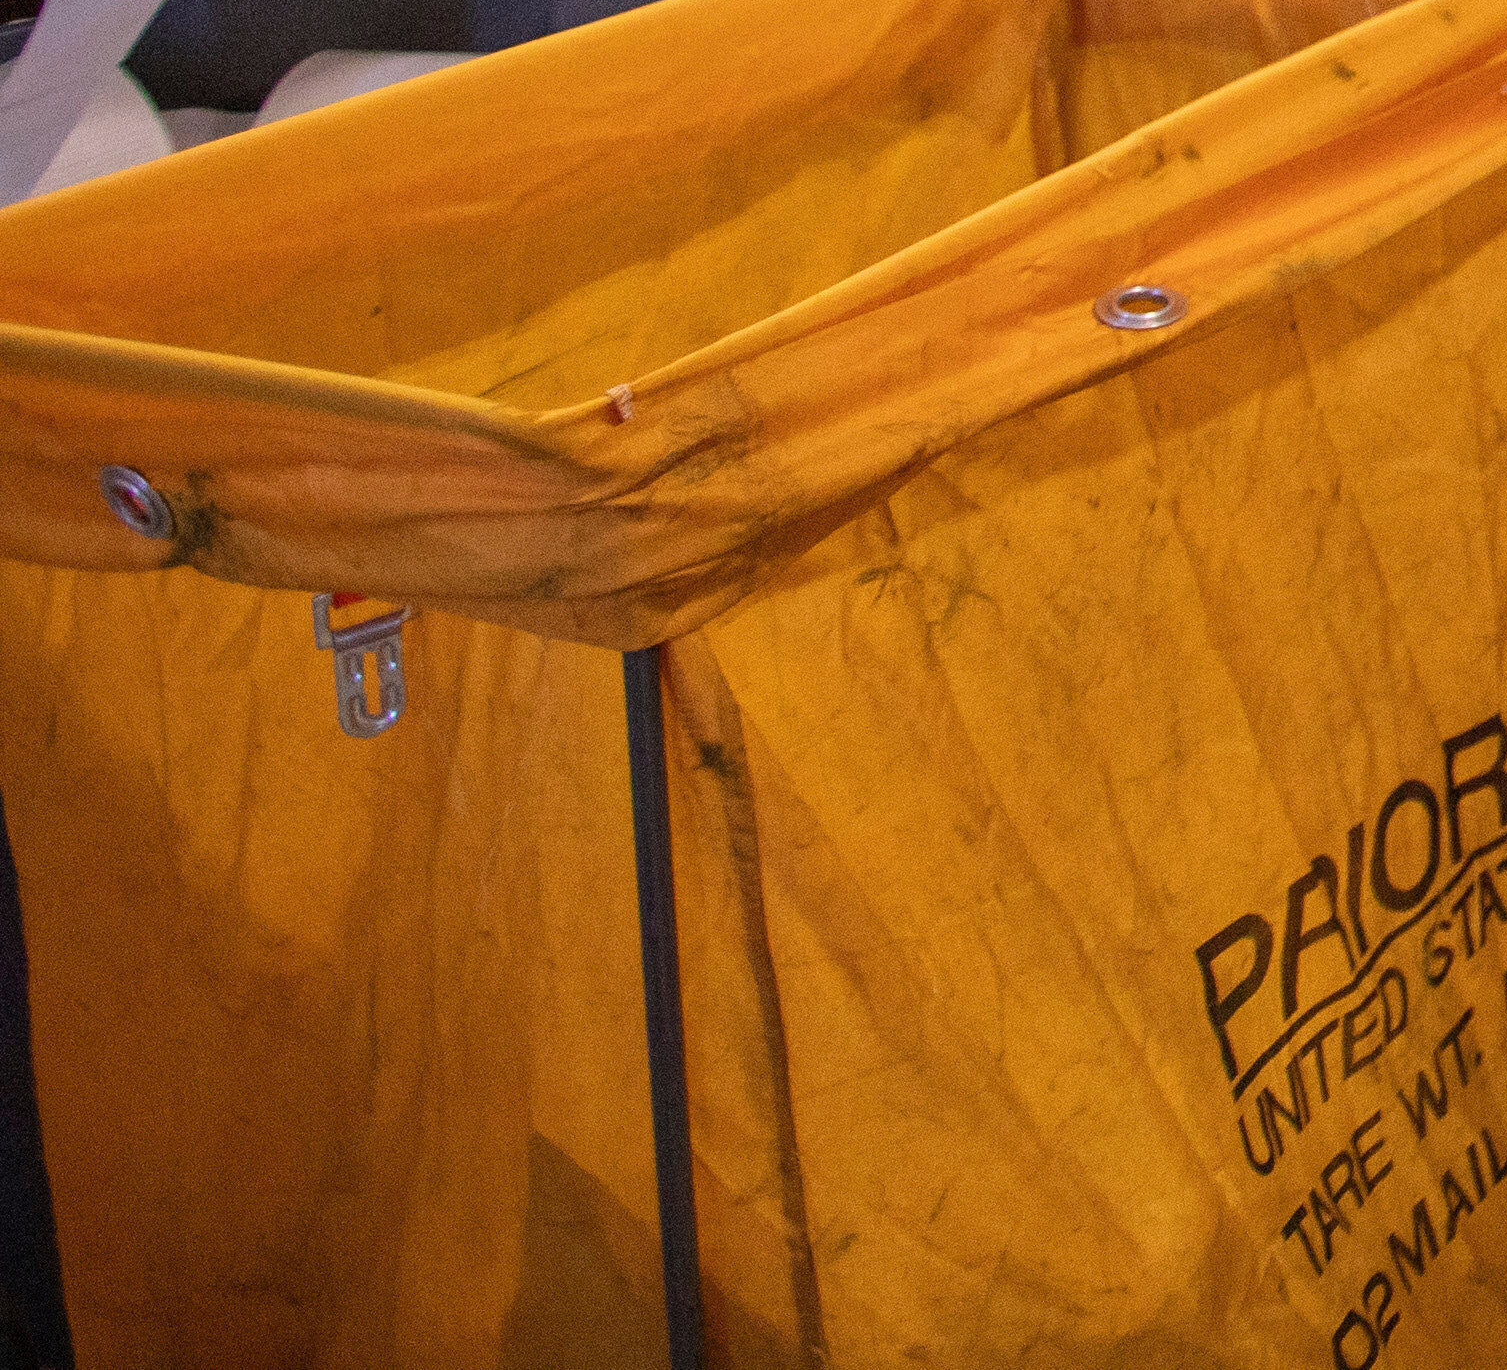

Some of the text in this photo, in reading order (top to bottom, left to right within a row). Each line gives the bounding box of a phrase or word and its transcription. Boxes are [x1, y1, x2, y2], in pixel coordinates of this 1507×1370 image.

[1238, 967, 1408, 1177] UNITED
[1280, 1109, 1395, 1275] TARE
[1396, 1007, 1482, 1142] WT.
